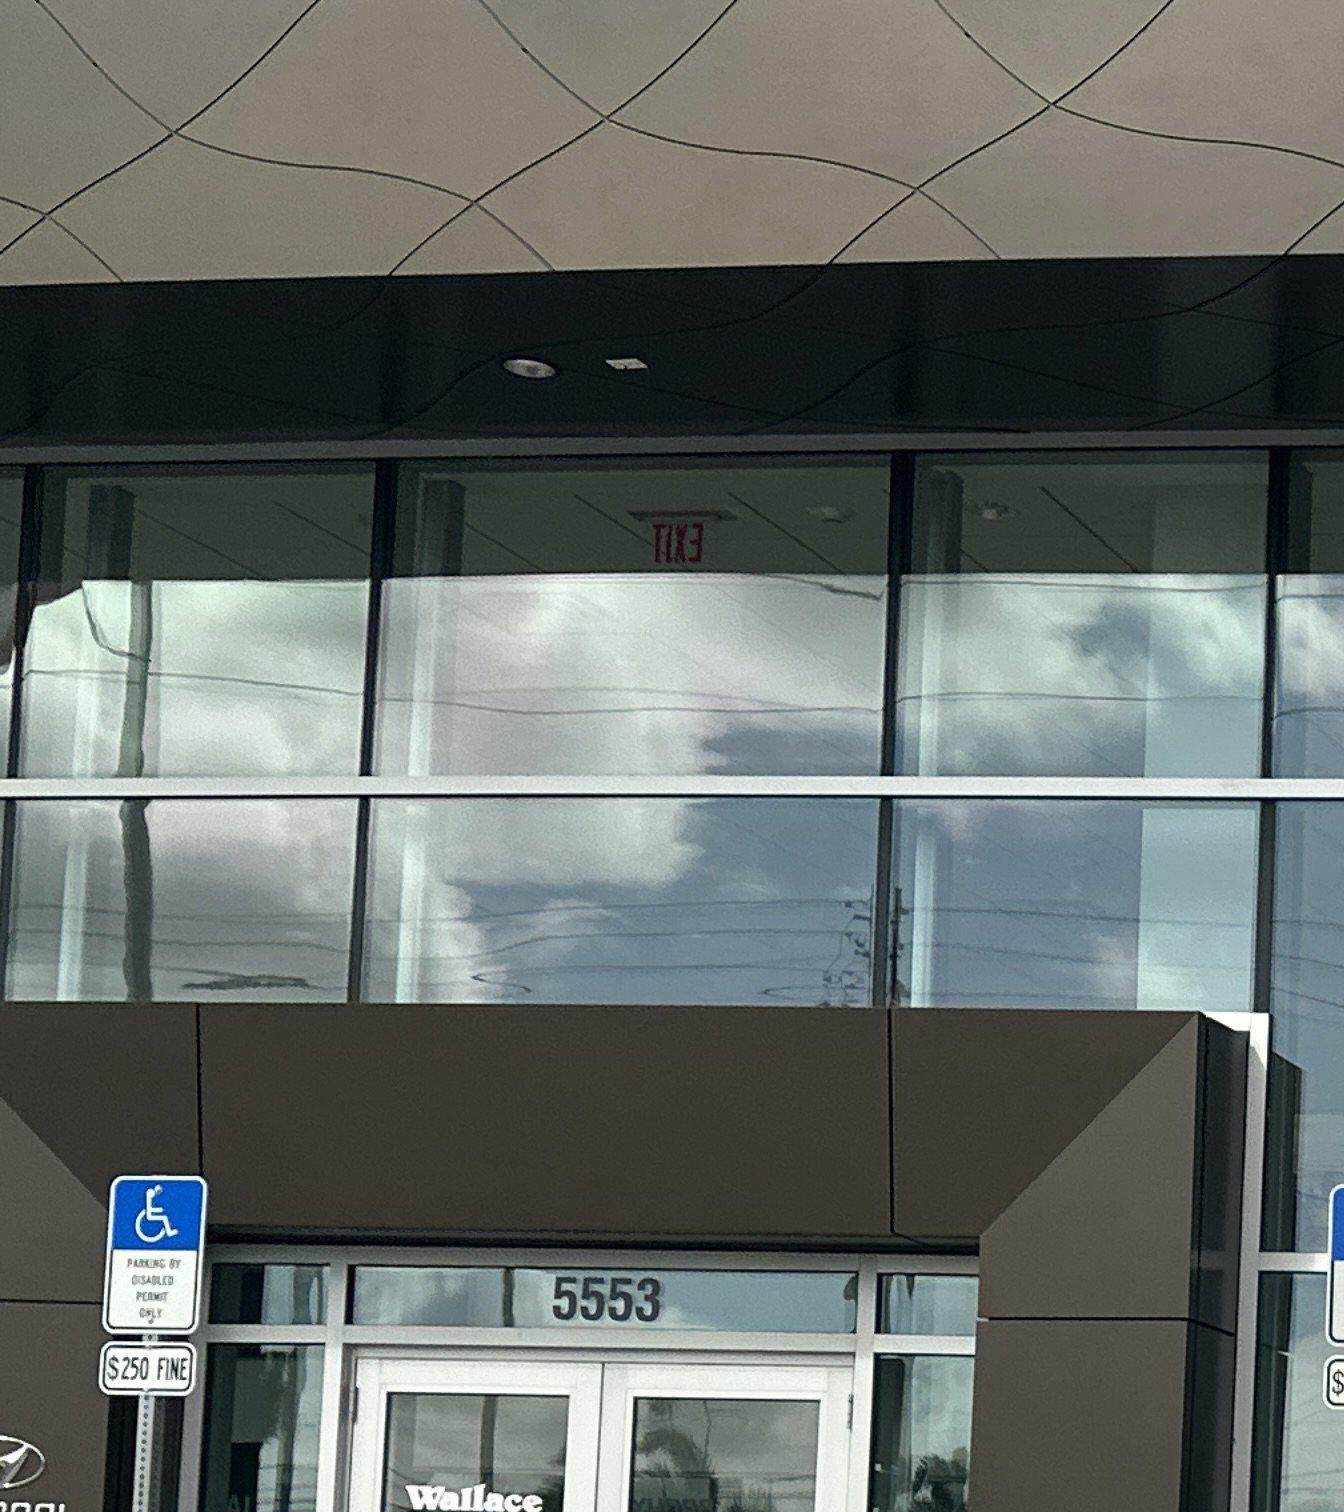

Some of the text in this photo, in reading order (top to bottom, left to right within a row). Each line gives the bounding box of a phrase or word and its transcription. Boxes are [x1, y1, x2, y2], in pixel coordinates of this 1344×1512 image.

[127, 1258, 182, 1269] PARKING BY
[131, 1275, 174, 1286] DISABLED
[136, 1291, 169, 1302] PERMIT
[552, 1276, 661, 1322] 5553
[139, 1308, 162, 1318] ONLY
[107, 1355, 188, 1380] $250 FINE
